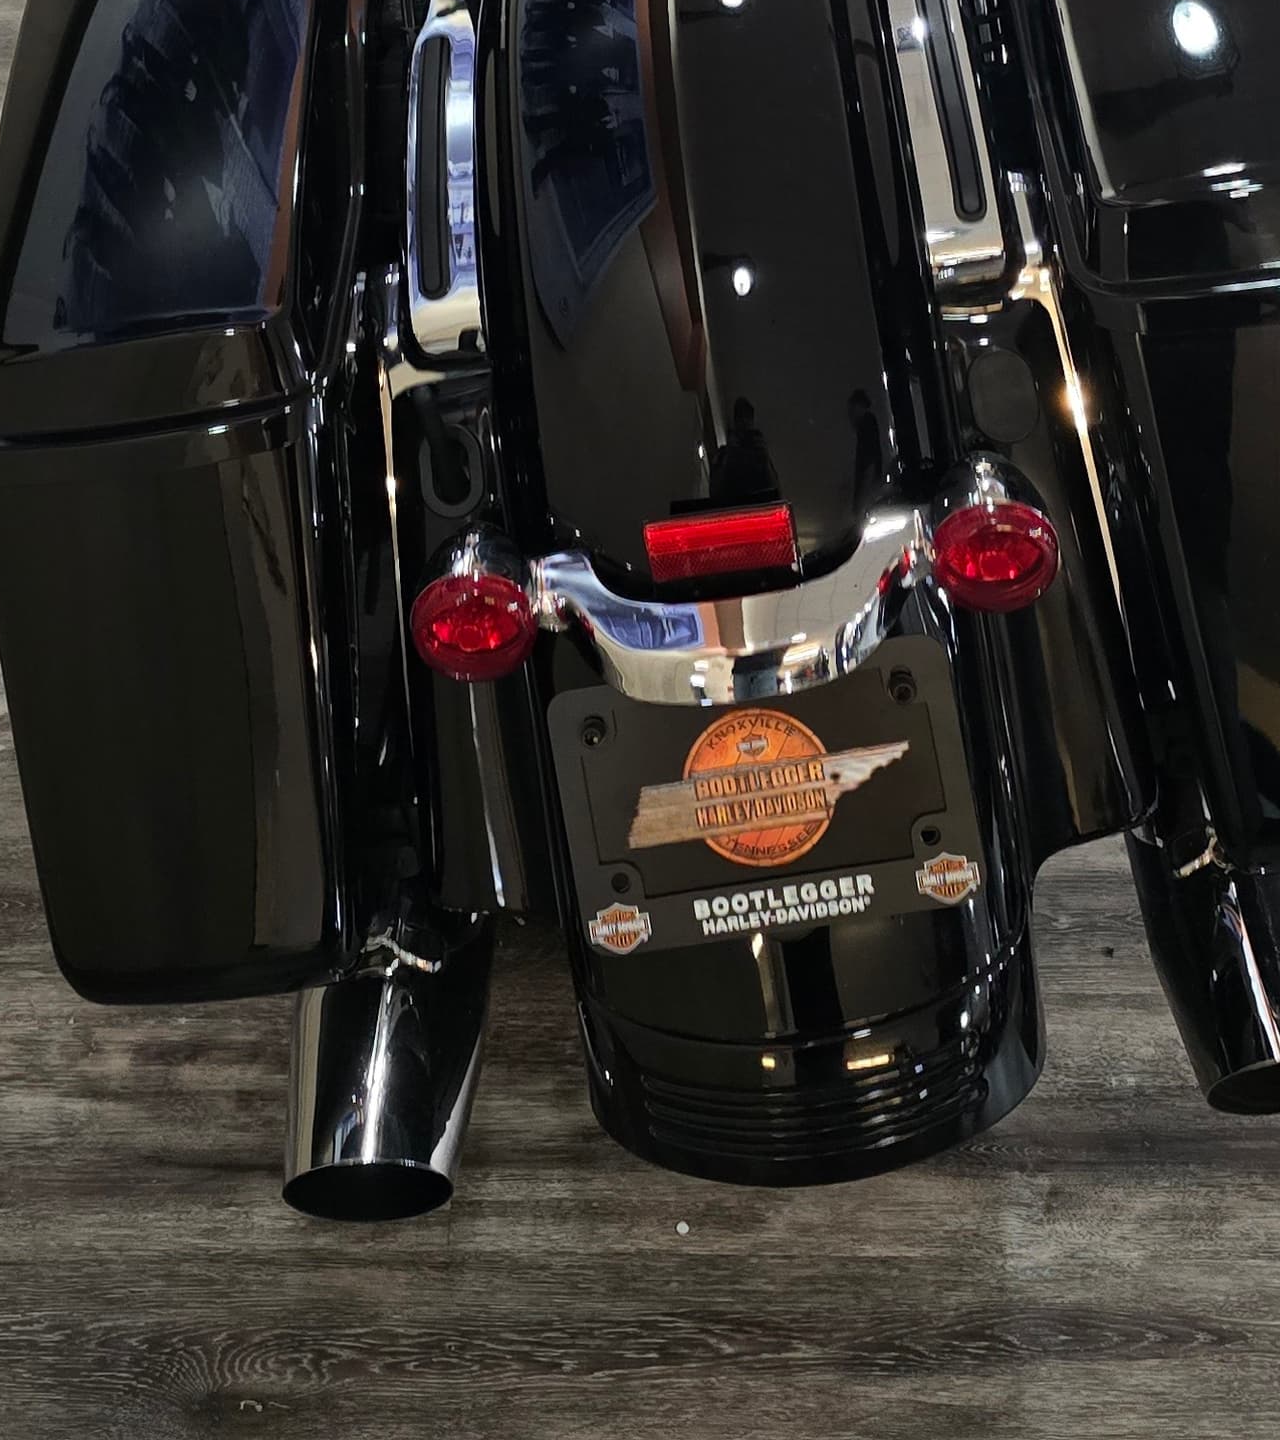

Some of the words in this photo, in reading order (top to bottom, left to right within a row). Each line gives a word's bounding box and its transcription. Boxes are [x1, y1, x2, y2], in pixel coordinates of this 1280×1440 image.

[706, 716, 796, 750] KNOXVILLE
[695, 760, 826, 801] BOOTLEGGER
[693, 873, 875, 921] BOOTLEGGER
